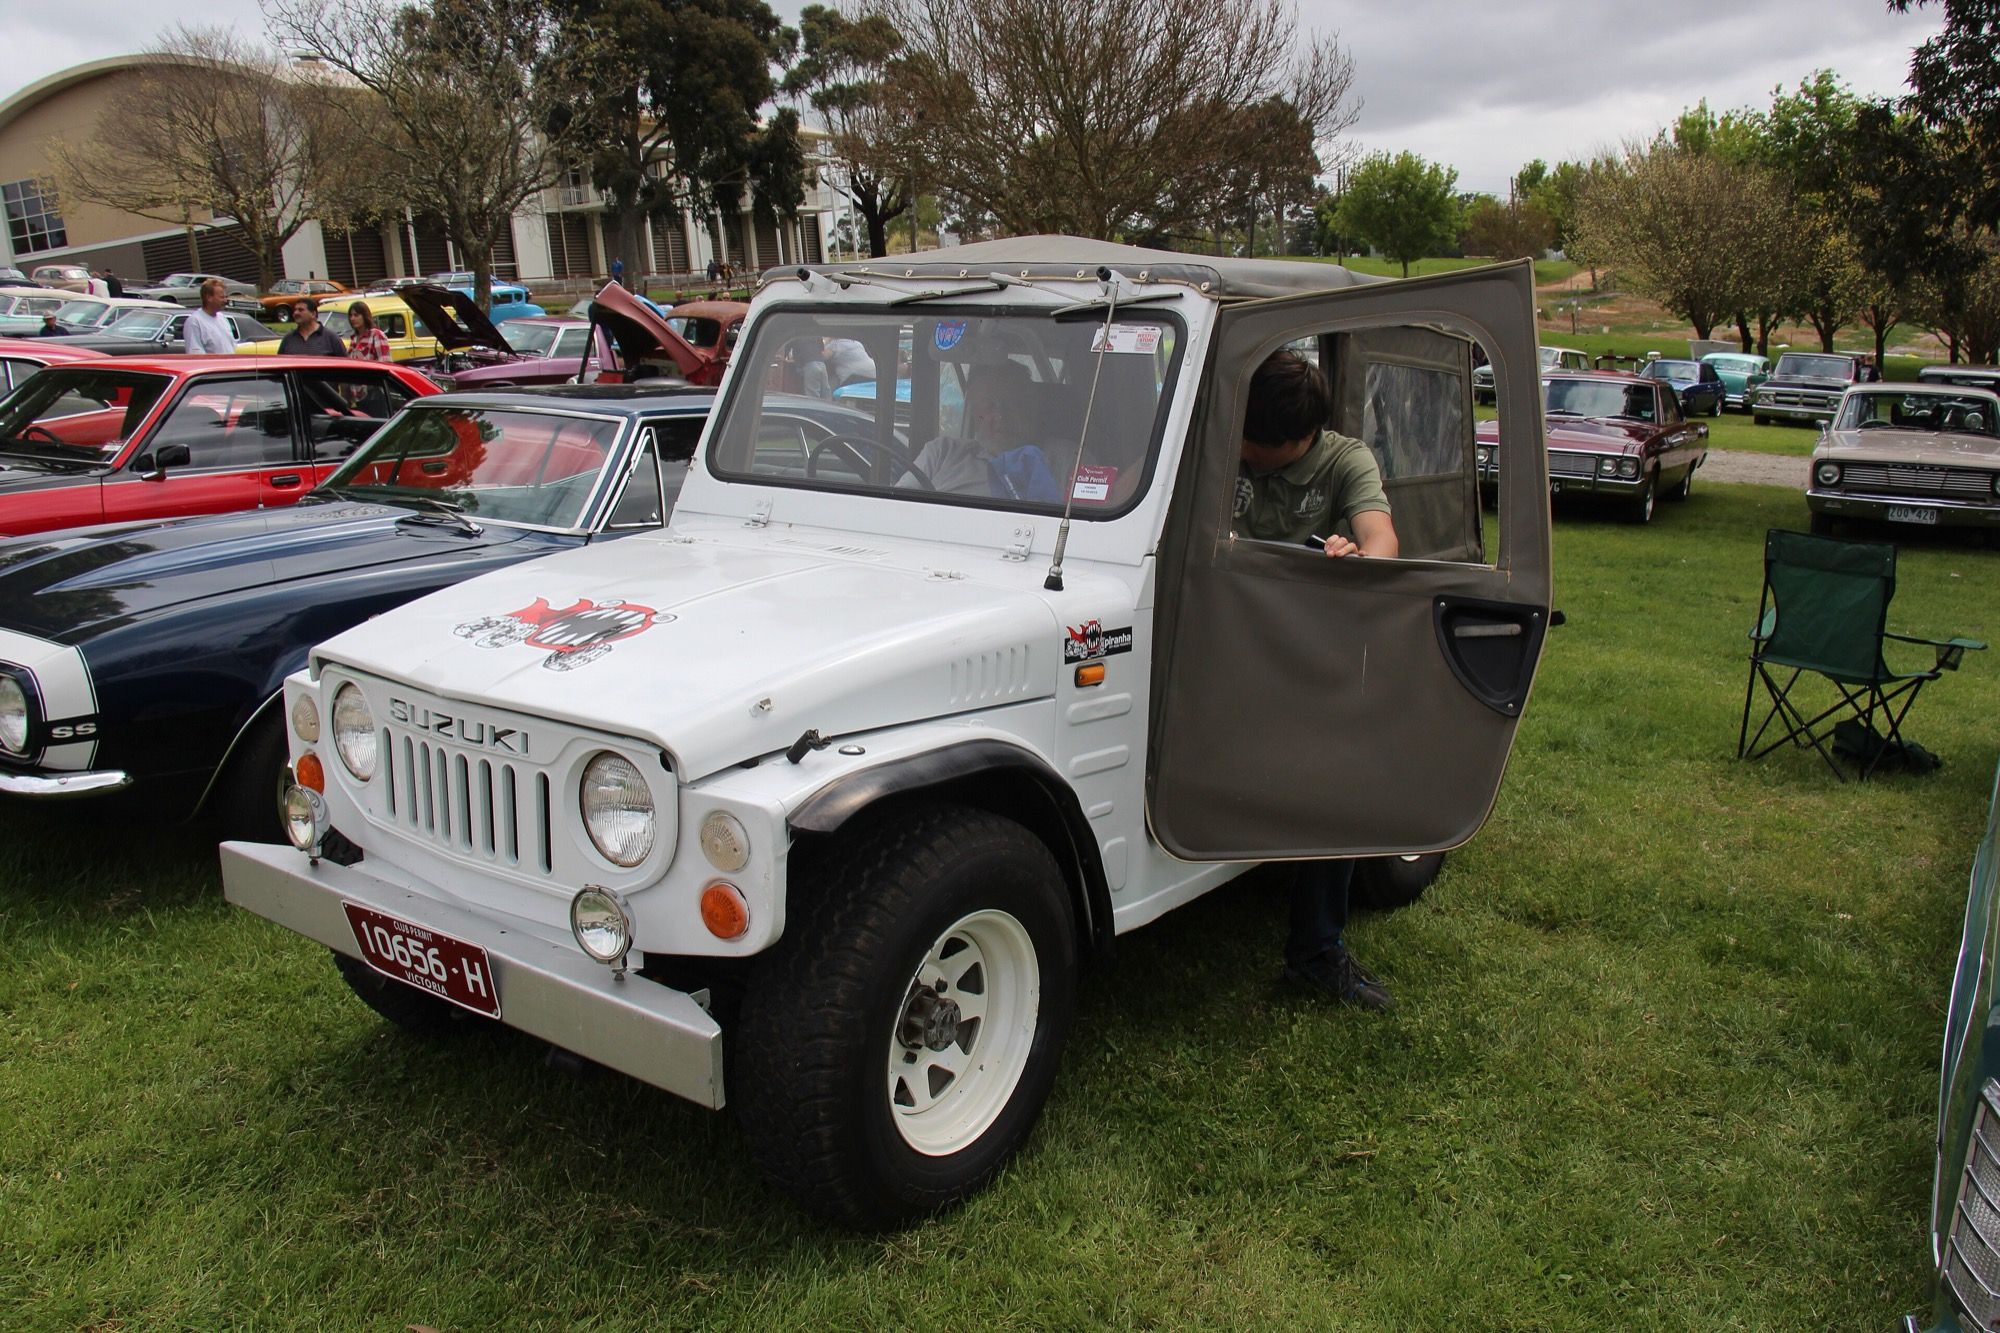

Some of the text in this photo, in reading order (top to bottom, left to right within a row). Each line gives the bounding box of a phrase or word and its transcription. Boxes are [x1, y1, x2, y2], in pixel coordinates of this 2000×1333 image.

[1916, 510, 1935, 521] 428
[1104, 633, 1132, 649] piranha
[51, 722, 97, 739] SS
[389, 697, 530, 756] SUZUKI
[393, 920, 433, 942] CLUB PERMIT
[405, 970, 448, 996] VICTORIA
